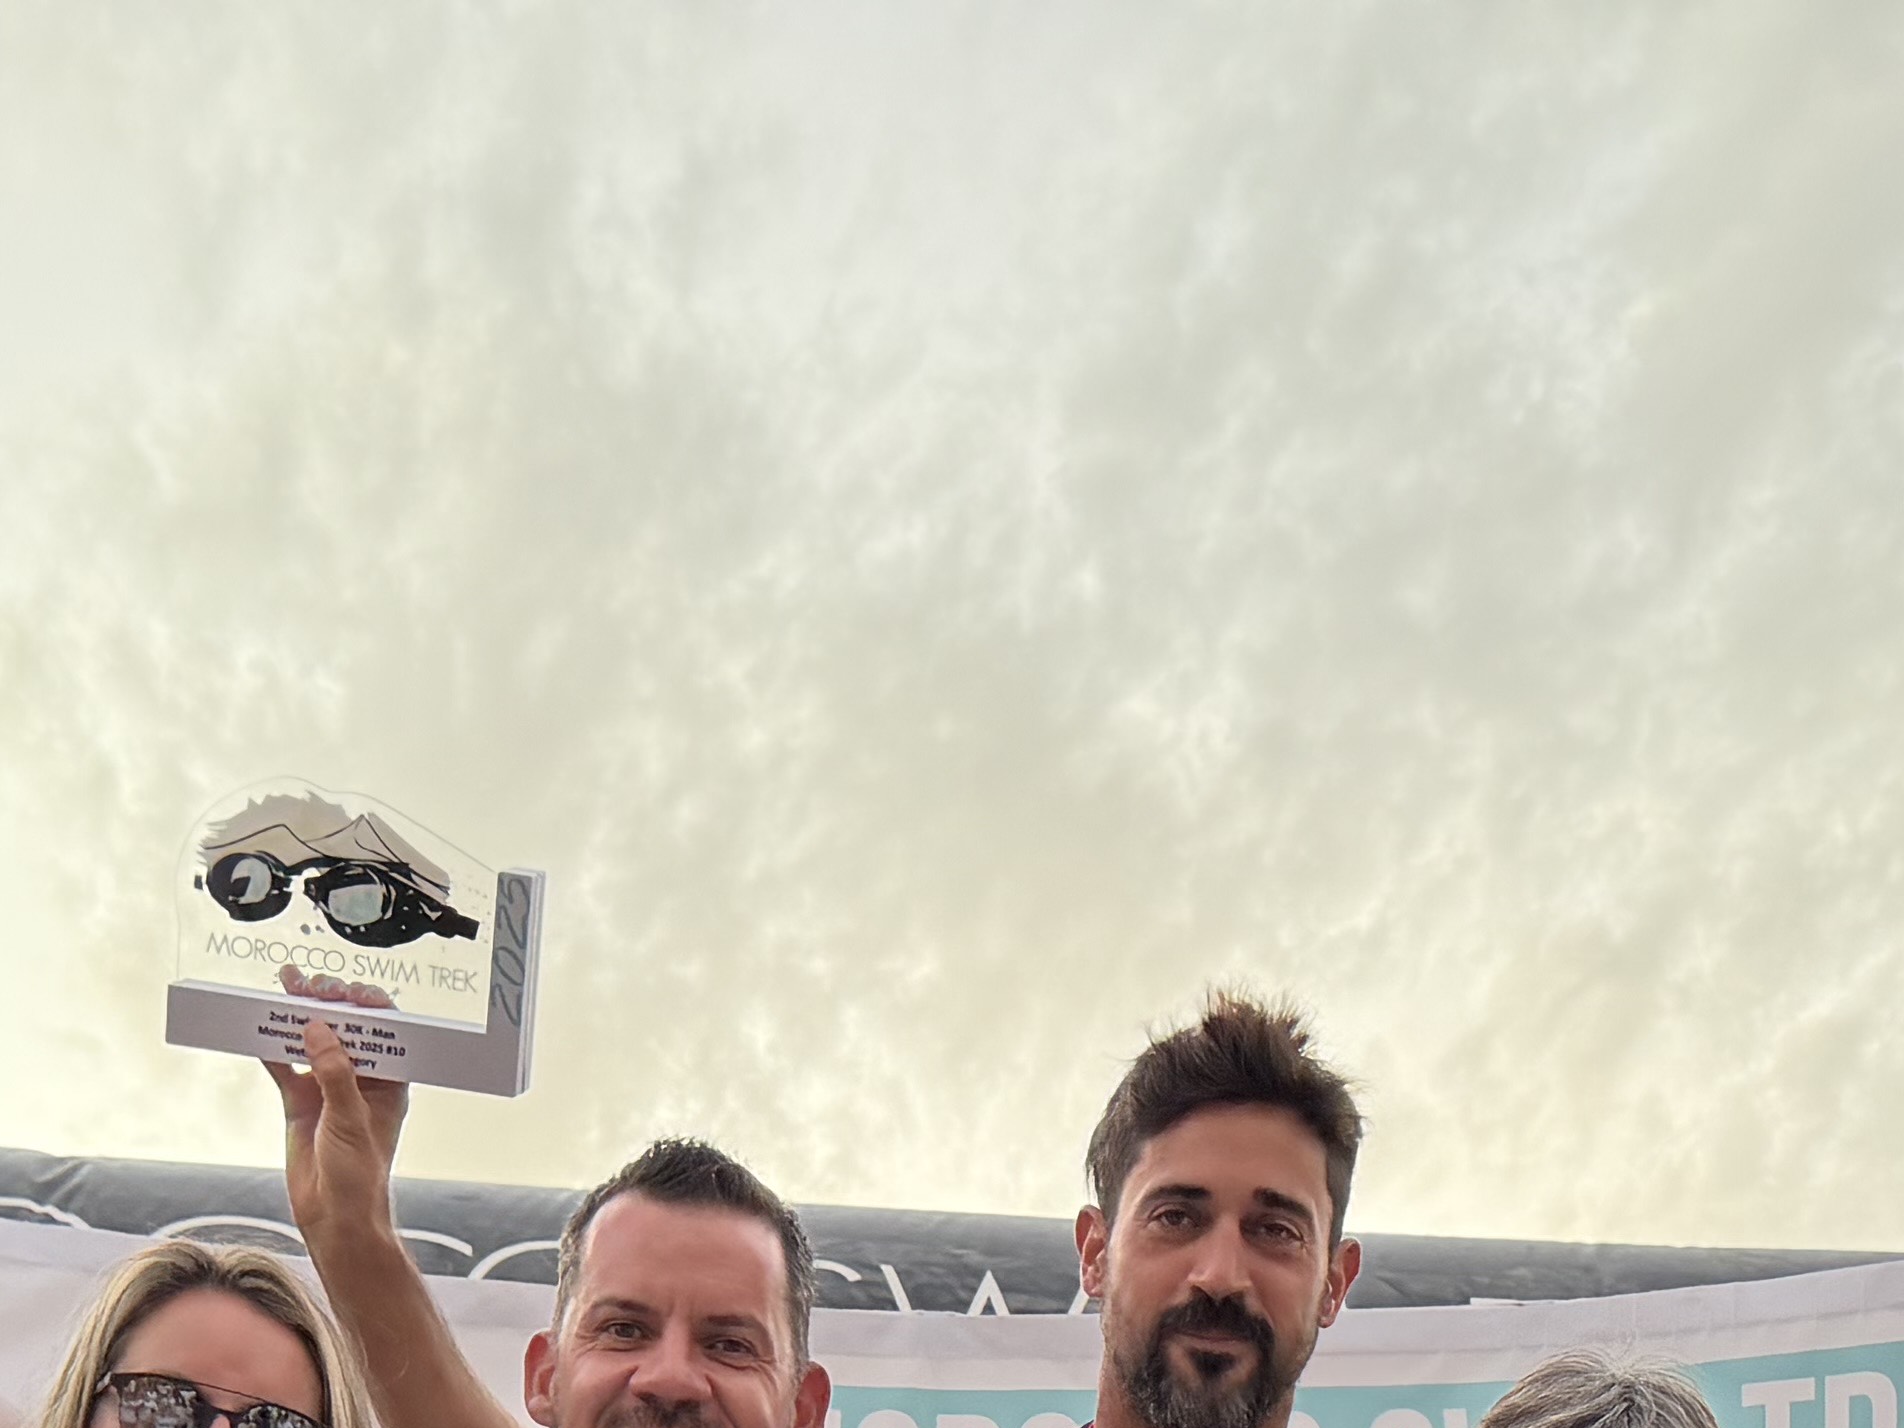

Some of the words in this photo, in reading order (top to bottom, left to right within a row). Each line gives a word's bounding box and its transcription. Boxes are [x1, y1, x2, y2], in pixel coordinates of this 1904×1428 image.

[206, 933, 346, 972] MOROCCO
[352, 955, 420, 985] SWIM
[429, 965, 478, 993] TREK
[372, 1028, 395, 1039] Man
[339, 1038, 356, 1049] rek
[360, 1041, 383, 1054] 2025
